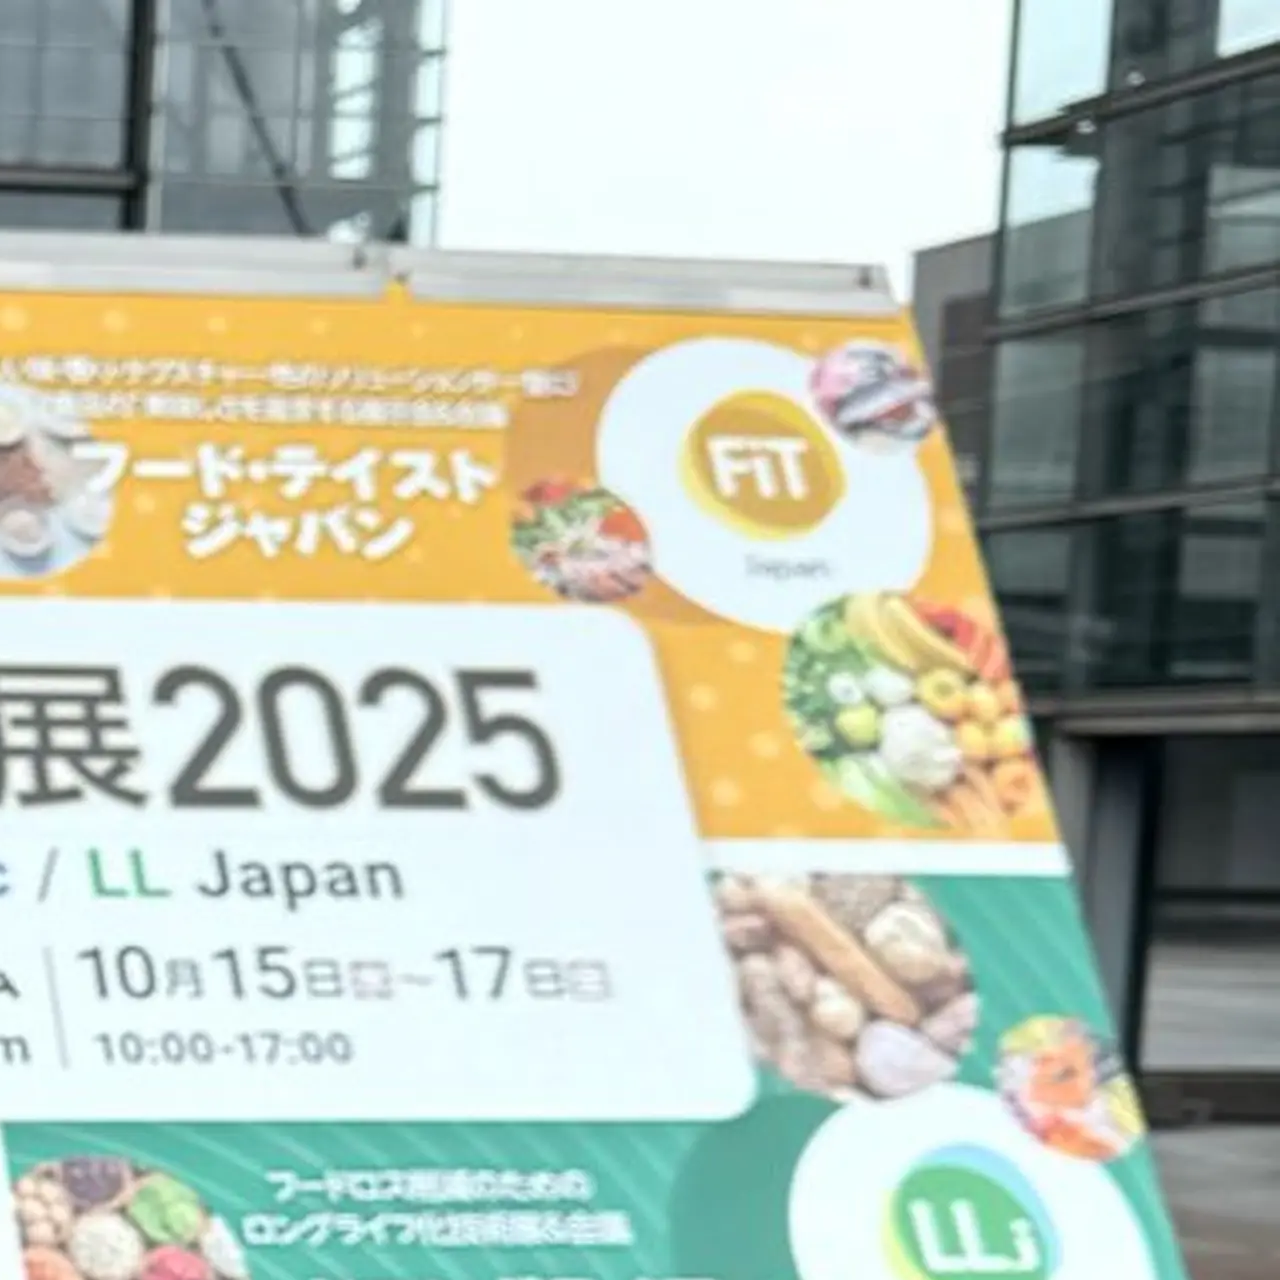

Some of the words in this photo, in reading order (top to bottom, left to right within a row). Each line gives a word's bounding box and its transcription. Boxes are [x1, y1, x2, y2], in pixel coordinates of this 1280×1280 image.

[707, 436, 809, 500] FiT
[180, 504, 416, 562] ジャパン
[88, 849, 171, 899] LL
[198, 850, 405, 910] Japan
